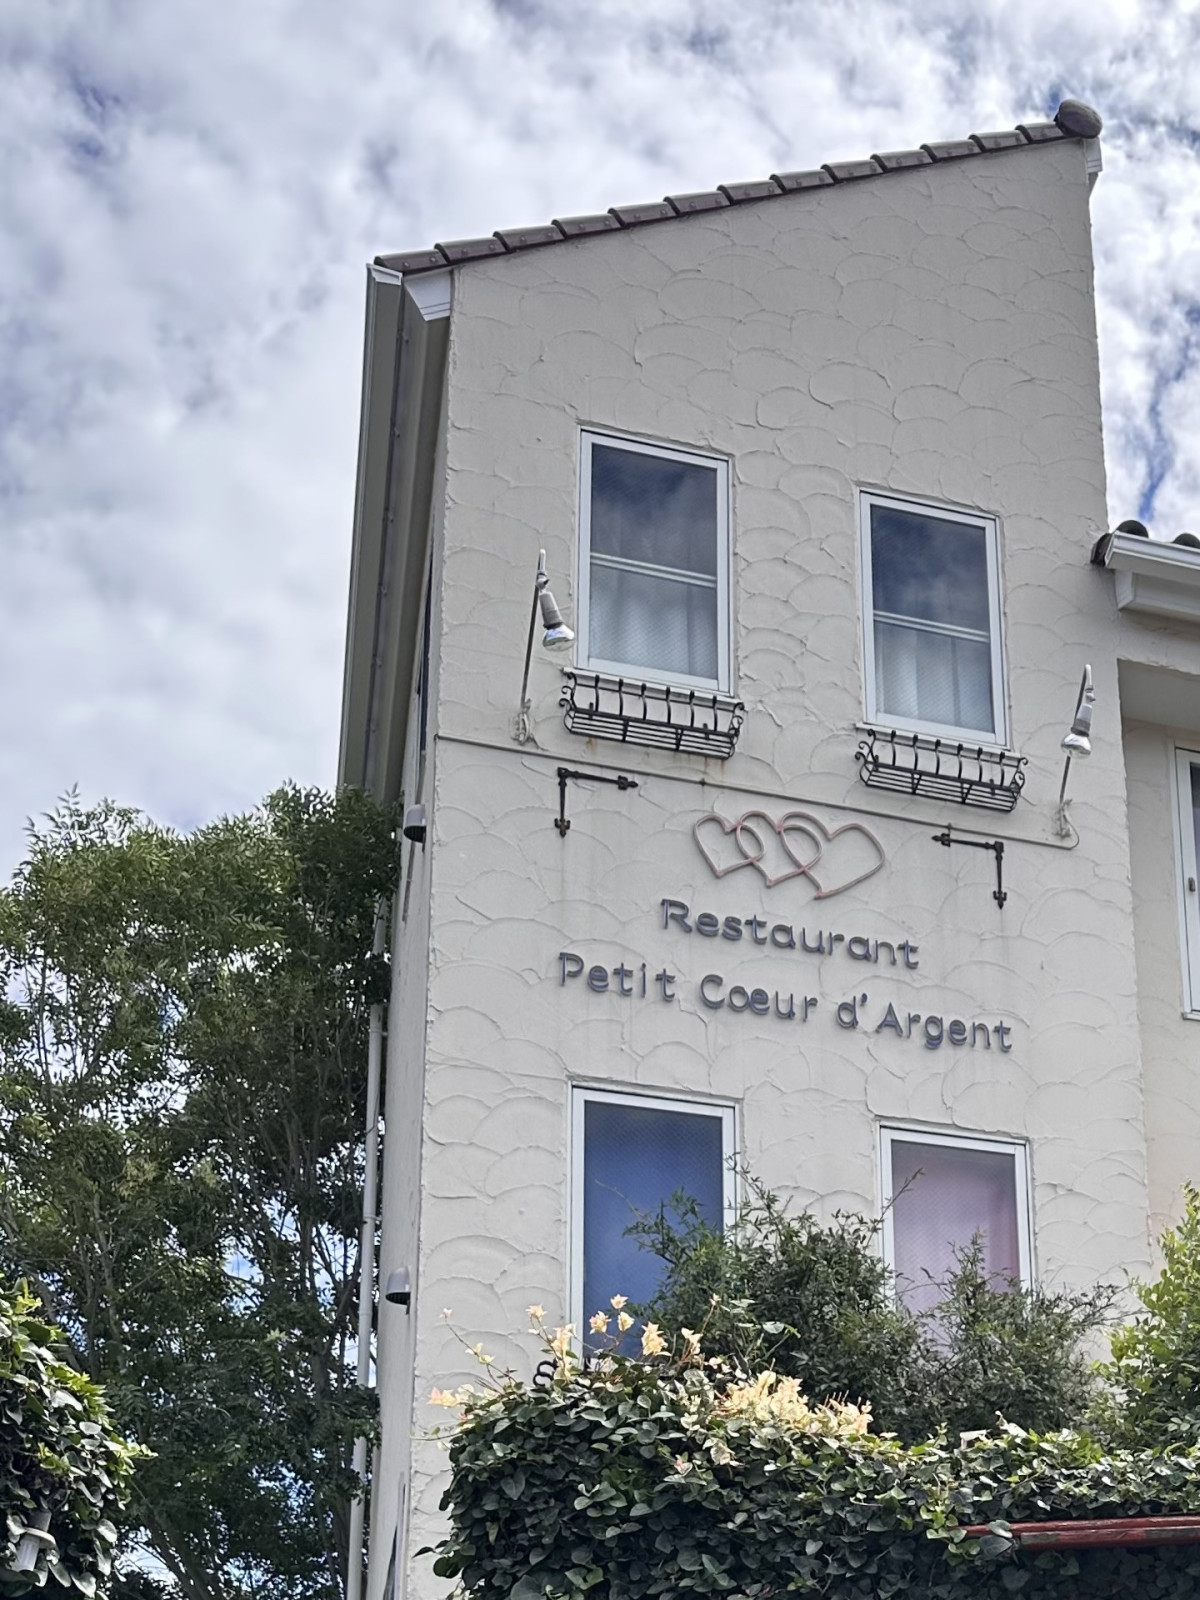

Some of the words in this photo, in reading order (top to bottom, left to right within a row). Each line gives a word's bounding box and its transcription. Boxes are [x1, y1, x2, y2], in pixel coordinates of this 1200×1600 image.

[661, 898, 919, 970] Restaurant
[558, 952, 677, 1000] Petit
[699, 974, 818, 1022] Cœur
[837, 993, 1012, 1052] d'Argent
